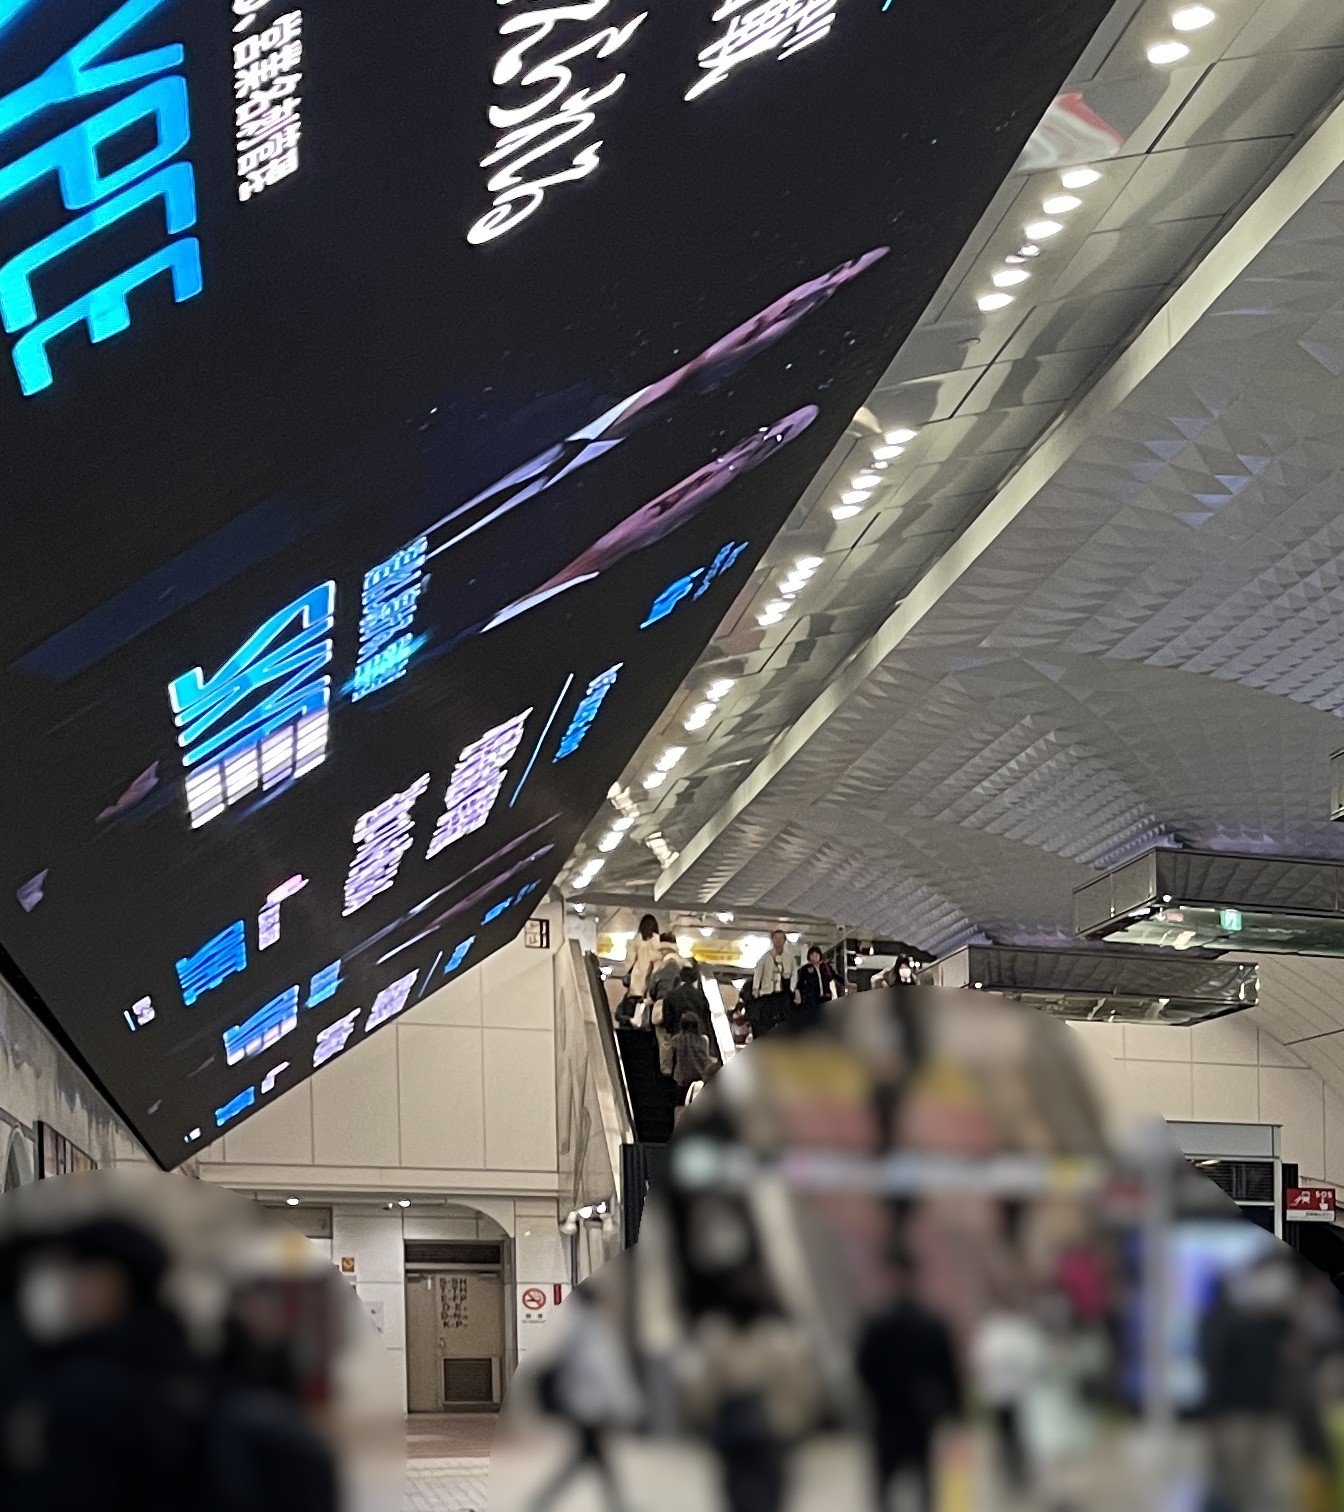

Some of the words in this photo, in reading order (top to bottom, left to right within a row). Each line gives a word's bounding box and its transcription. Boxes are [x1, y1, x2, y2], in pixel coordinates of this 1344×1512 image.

[0, 0, 203, 396] YPCE
[232, 0, 303, 202] 、営業名刺管理
